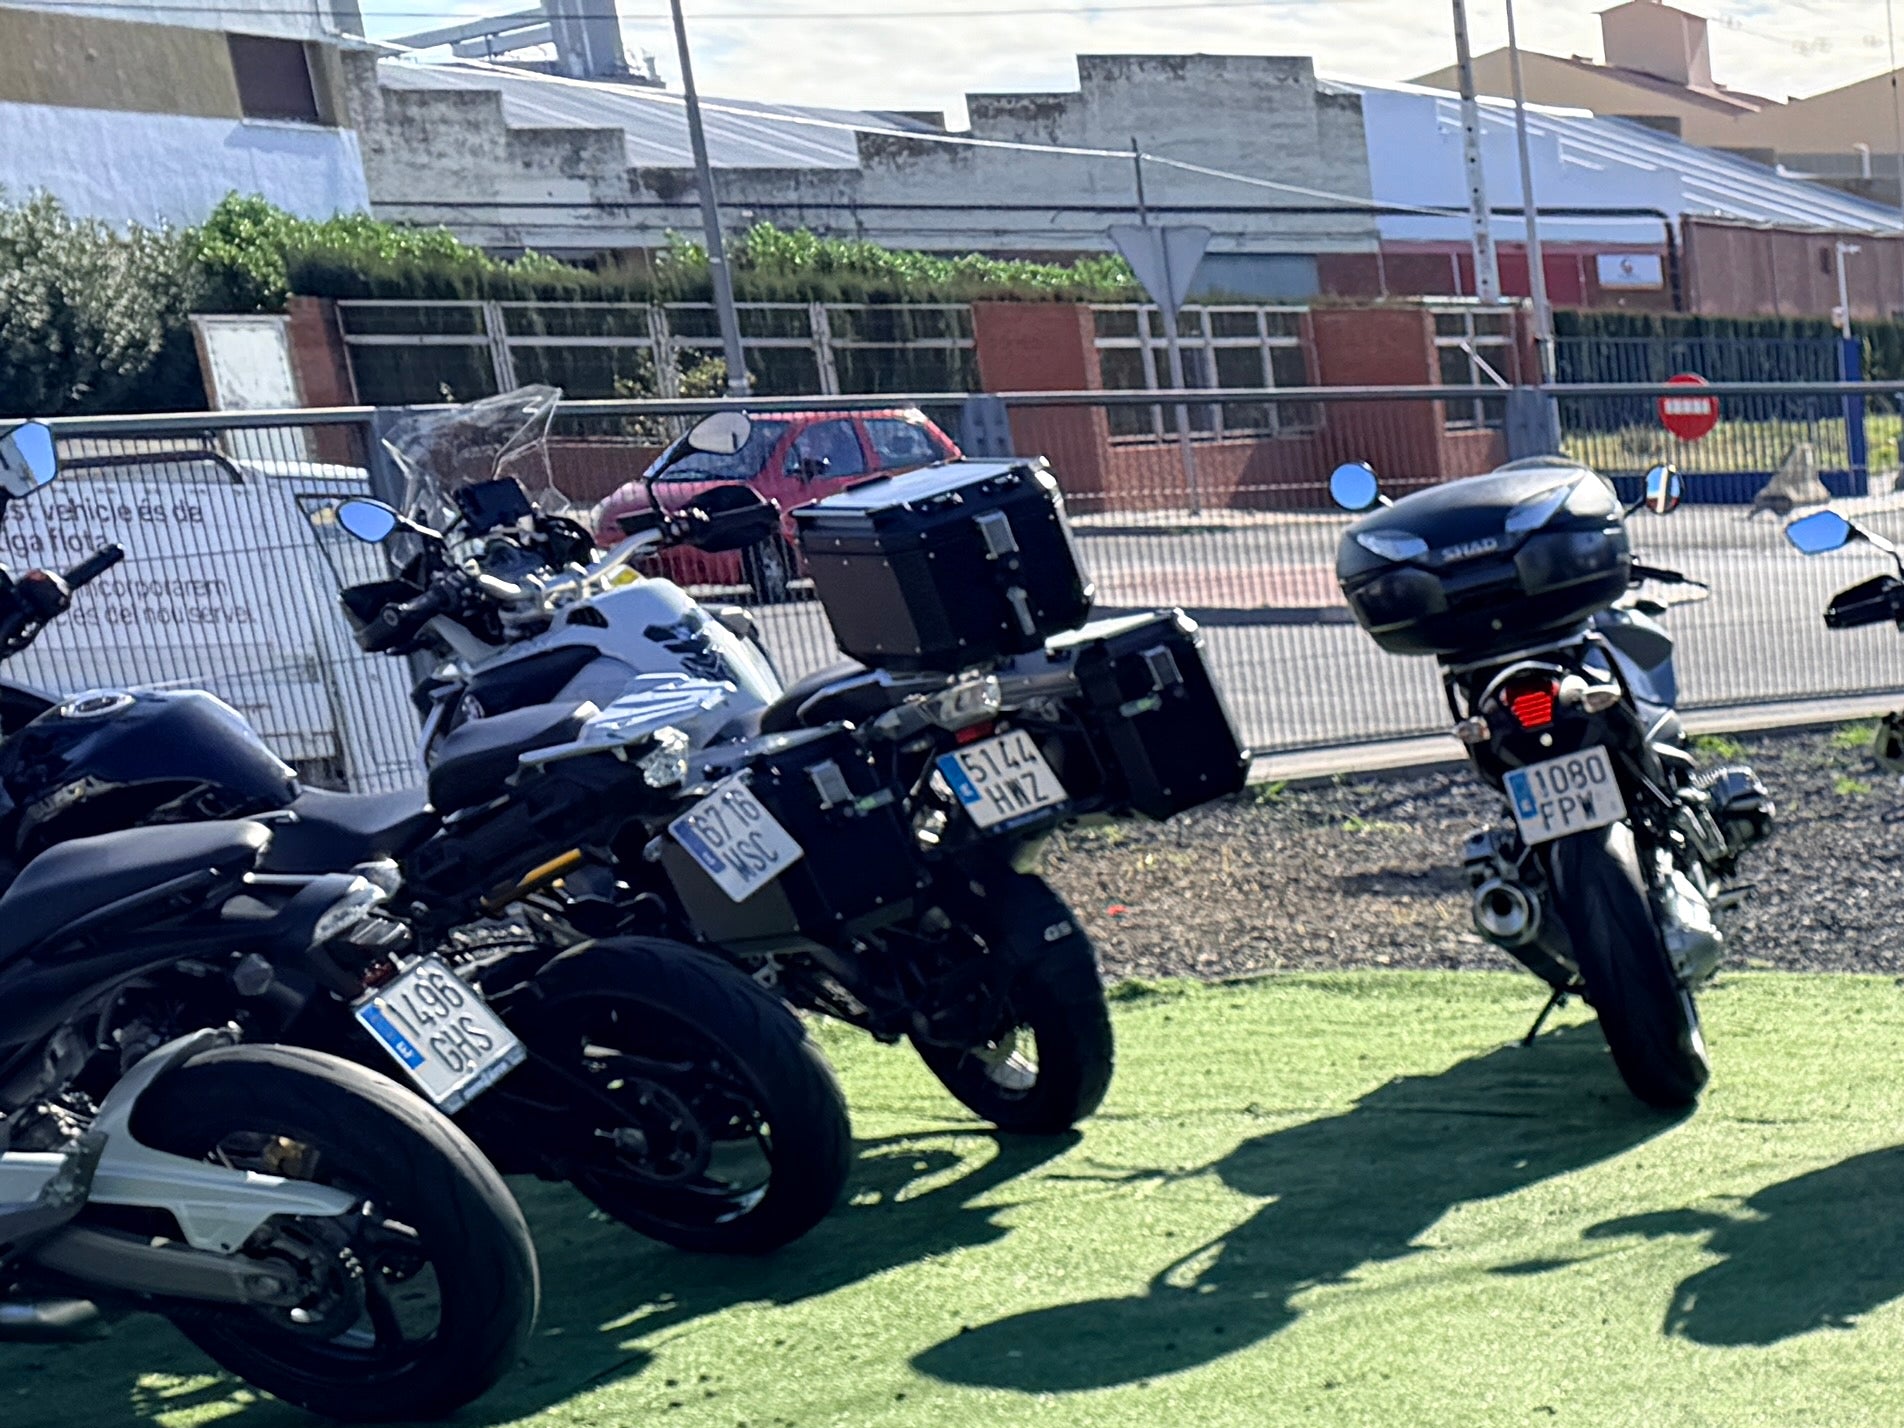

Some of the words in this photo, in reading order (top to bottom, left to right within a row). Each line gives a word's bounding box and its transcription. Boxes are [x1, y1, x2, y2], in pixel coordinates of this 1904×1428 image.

[960, 735, 1037, 783] 5144
[1534, 754, 1607, 798] 1080
[692, 789, 762, 849] 6716
[387, 972, 464, 1039] 1496
[429, 1016, 494, 1073] GHS
